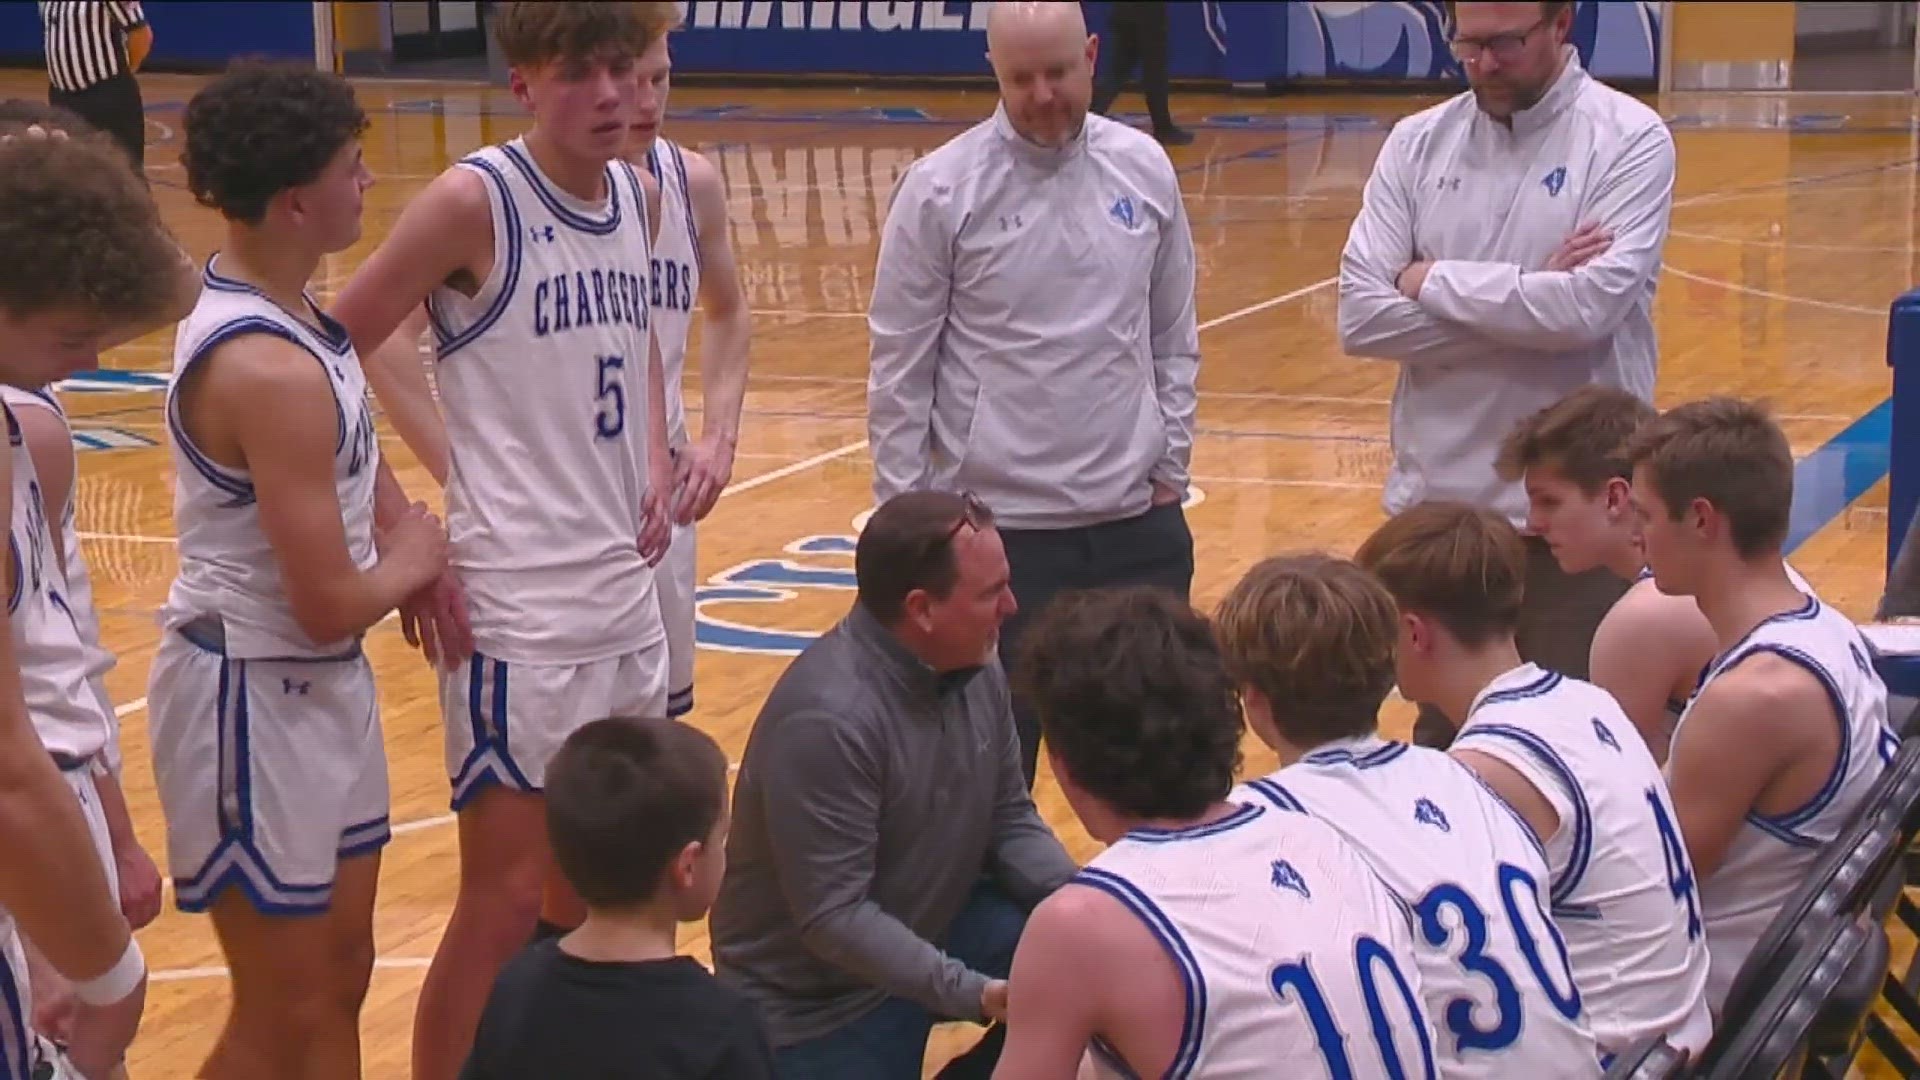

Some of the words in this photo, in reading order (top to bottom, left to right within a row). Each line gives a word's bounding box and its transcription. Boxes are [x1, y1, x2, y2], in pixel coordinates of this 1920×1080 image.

[534, 267, 649, 337] CHARGERS
[595, 355, 625, 439] 5
[1645, 785, 1702, 941] 4
[1269, 933, 1437, 1080] 10
[1413, 861, 1583, 1054] 30
